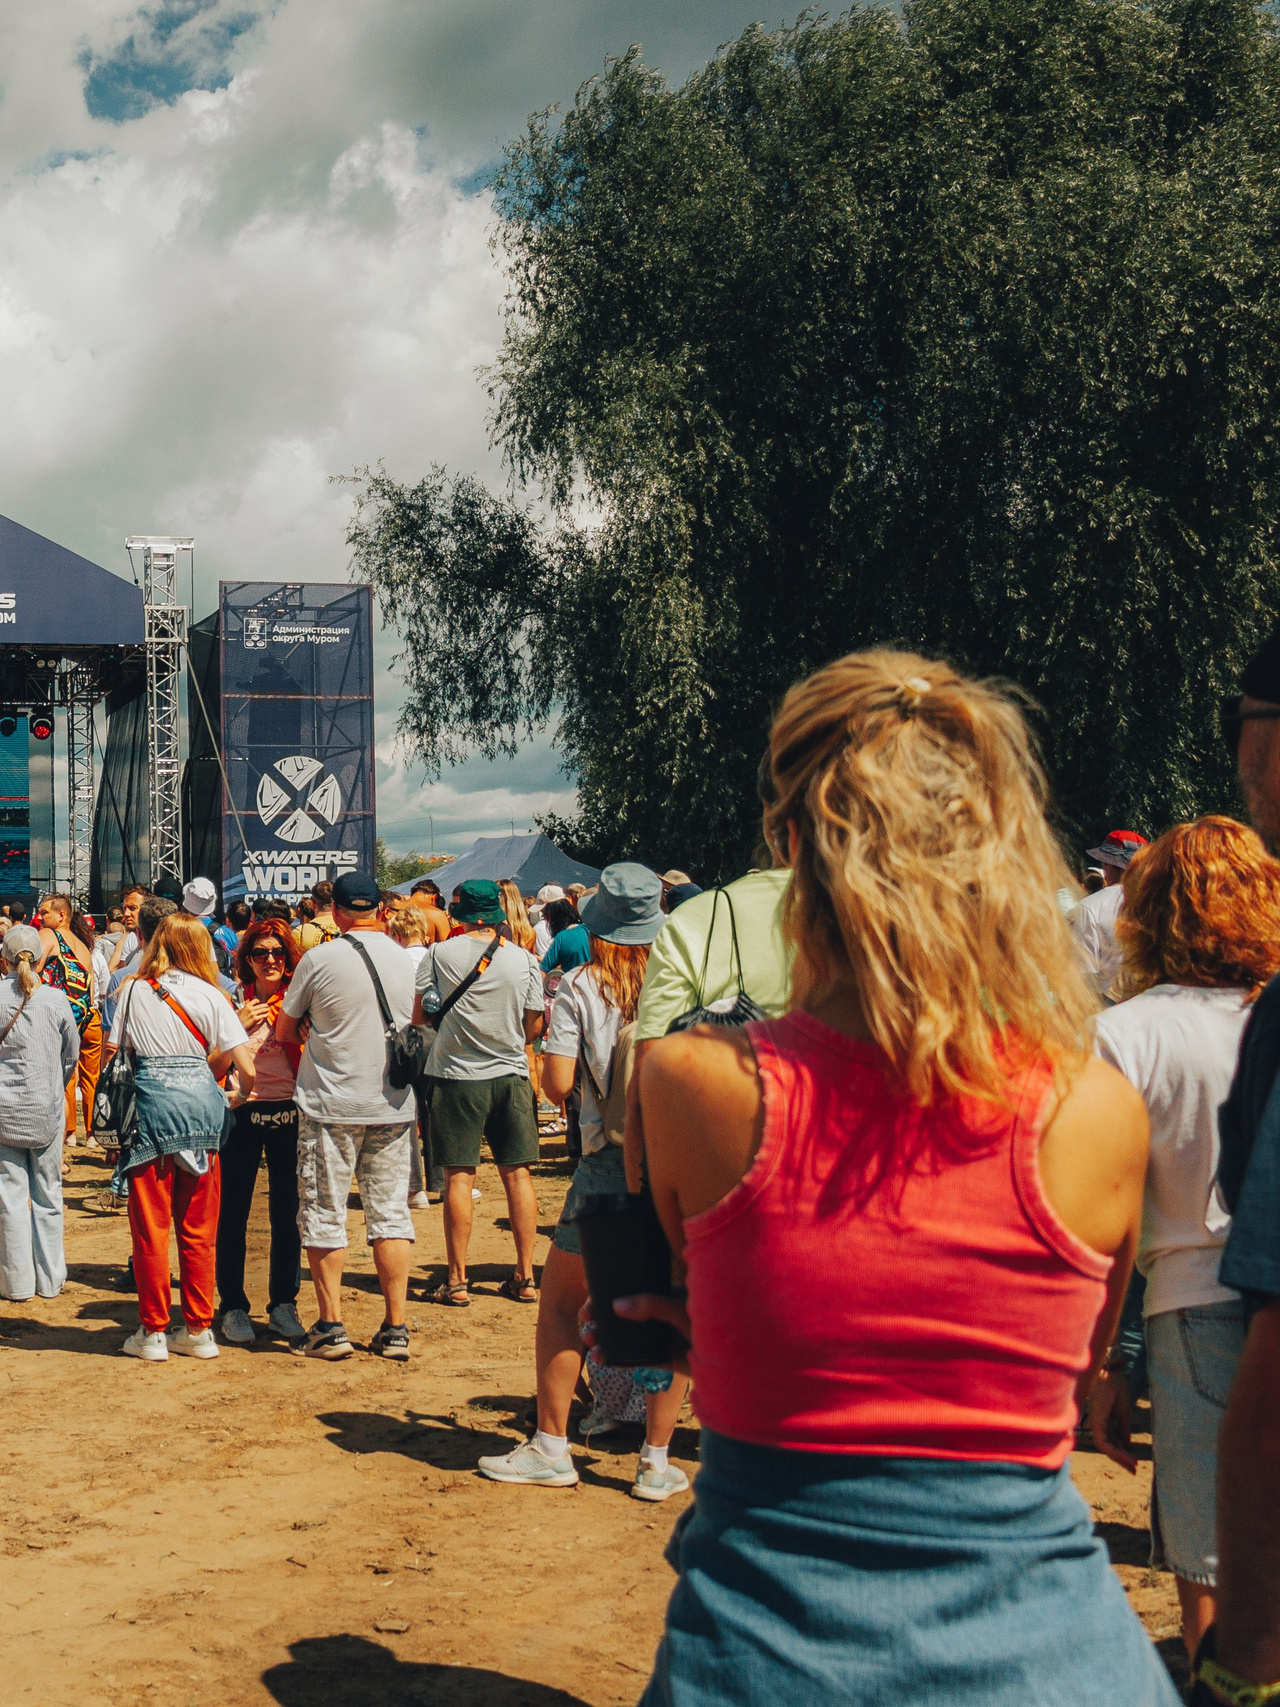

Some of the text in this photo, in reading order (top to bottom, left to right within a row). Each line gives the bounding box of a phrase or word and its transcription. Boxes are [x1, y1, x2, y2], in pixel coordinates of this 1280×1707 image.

[272, 625, 350, 636] Администрация
[272, 635, 340, 644] округа Муром
